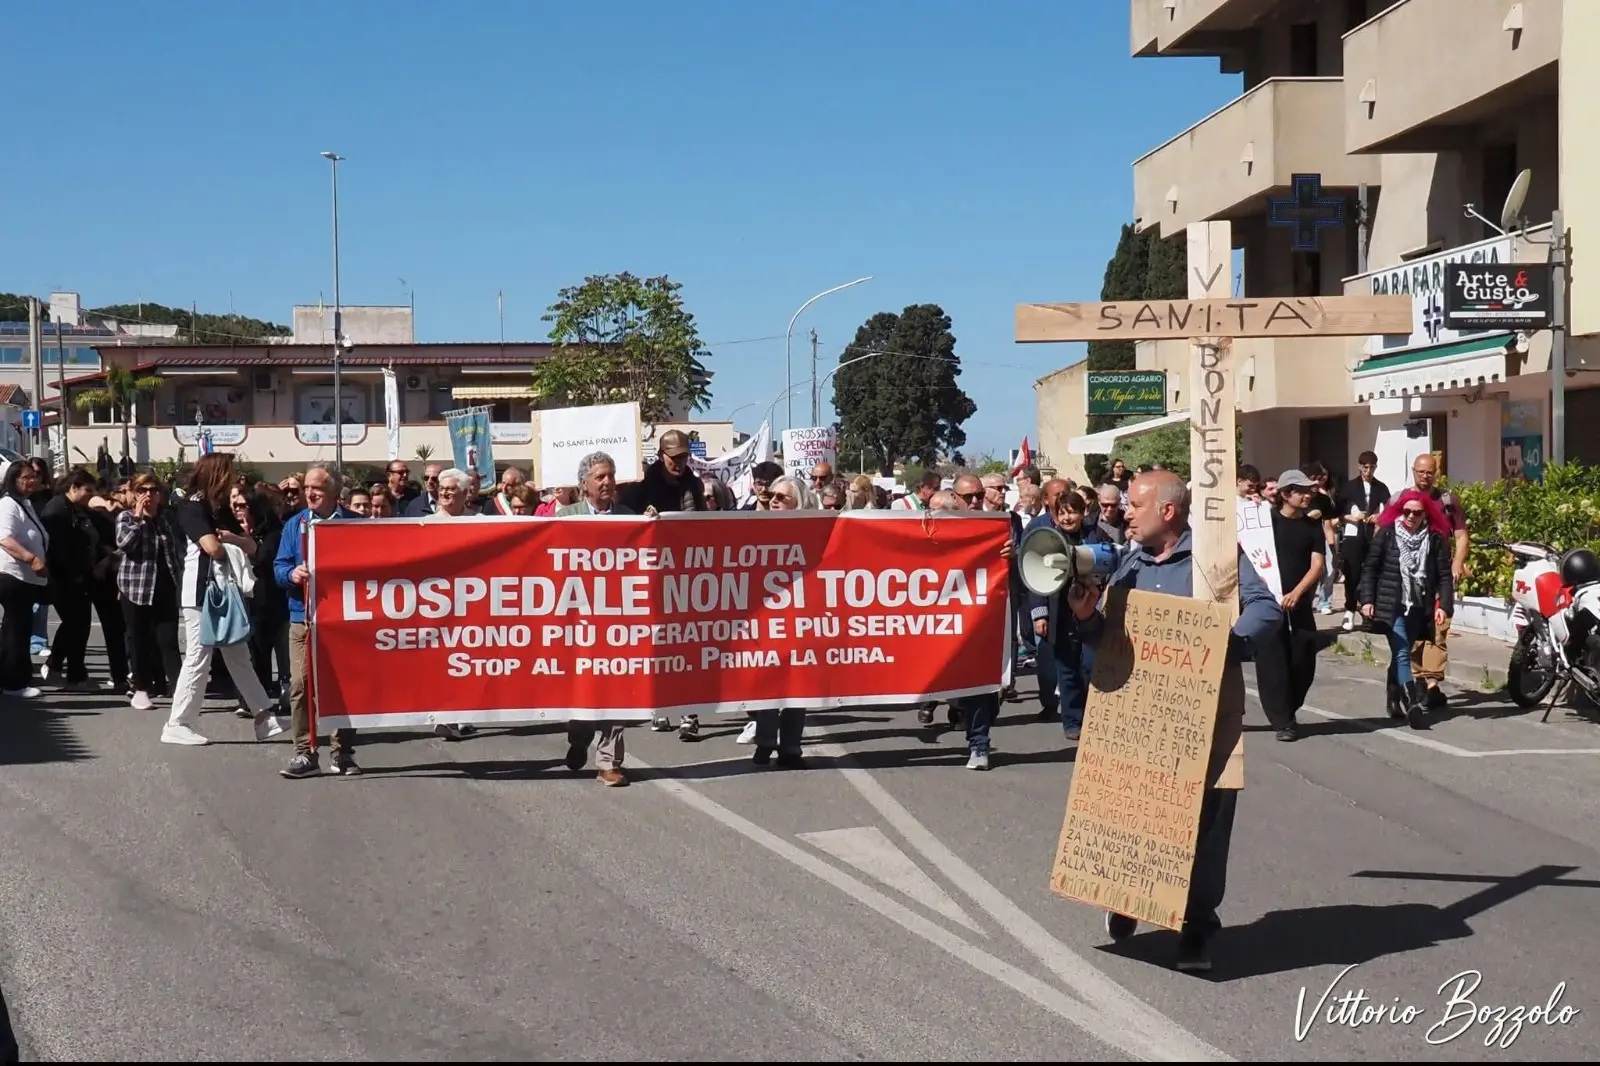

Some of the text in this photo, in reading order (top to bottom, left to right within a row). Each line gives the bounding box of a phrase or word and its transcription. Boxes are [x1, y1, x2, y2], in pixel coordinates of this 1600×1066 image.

[1373, 247, 1499, 297] PARAFARIA
[1456, 269, 1528, 287] Arte &
[1463, 285, 1529, 304] Gusto
[1089, 375, 1130, 383] CONSORZIO
[566, 437, 594, 447] SANITÀ
[595, 436, 628, 446] PRIVATA
[794, 440, 832, 451] OSPEDALE
[547, 544, 806, 571] TROPEA IN LOTTA
[342, 568, 987, 621] L'OSPEDALE NON SI TOCCA!
[375, 612, 963, 650] SERVONO PIÙ OPERATORI E PIÙ SERVIZI
[531, 657, 565, 675] AL
[575, 654, 693, 676] PROFITTO.
[790, 649, 818, 666] LA
[826, 647, 894, 665] CURA.
[1132, 699, 1139, 712] E
[1151, 688, 1202, 710] VENGONO
[1088, 706, 1206, 747] CHE MUORE A SERRA
[1088, 721, 1109, 737] SAN
[1113, 725, 1150, 748] BRUNO
[1171, 741, 1199, 761] PURE
[1084, 737, 1092, 748] A
[1096, 736, 1139, 761] TROPEA
[1082, 751, 1104, 768] NON
[1108, 758, 1141, 779] SIAMO
[1079, 767, 1193, 810] CARNE DA MACELLO
[1071, 799, 1138, 830] STABILIMENTO
[1076, 783, 1194, 830] DA SPOSTARE DA UNO
[1066, 828, 1081, 841] ZA
[1086, 836, 1098, 847] LA
[1102, 839, 1140, 861] NOSTRA
[1068, 815, 1142, 846] RIVENDICHIAMO
[1144, 840, 1157, 852] AD
[1060, 855, 1088, 873] ALLA
[1063, 841, 1189, 889] E QUINDI IL NOSTRO DIRITTO
